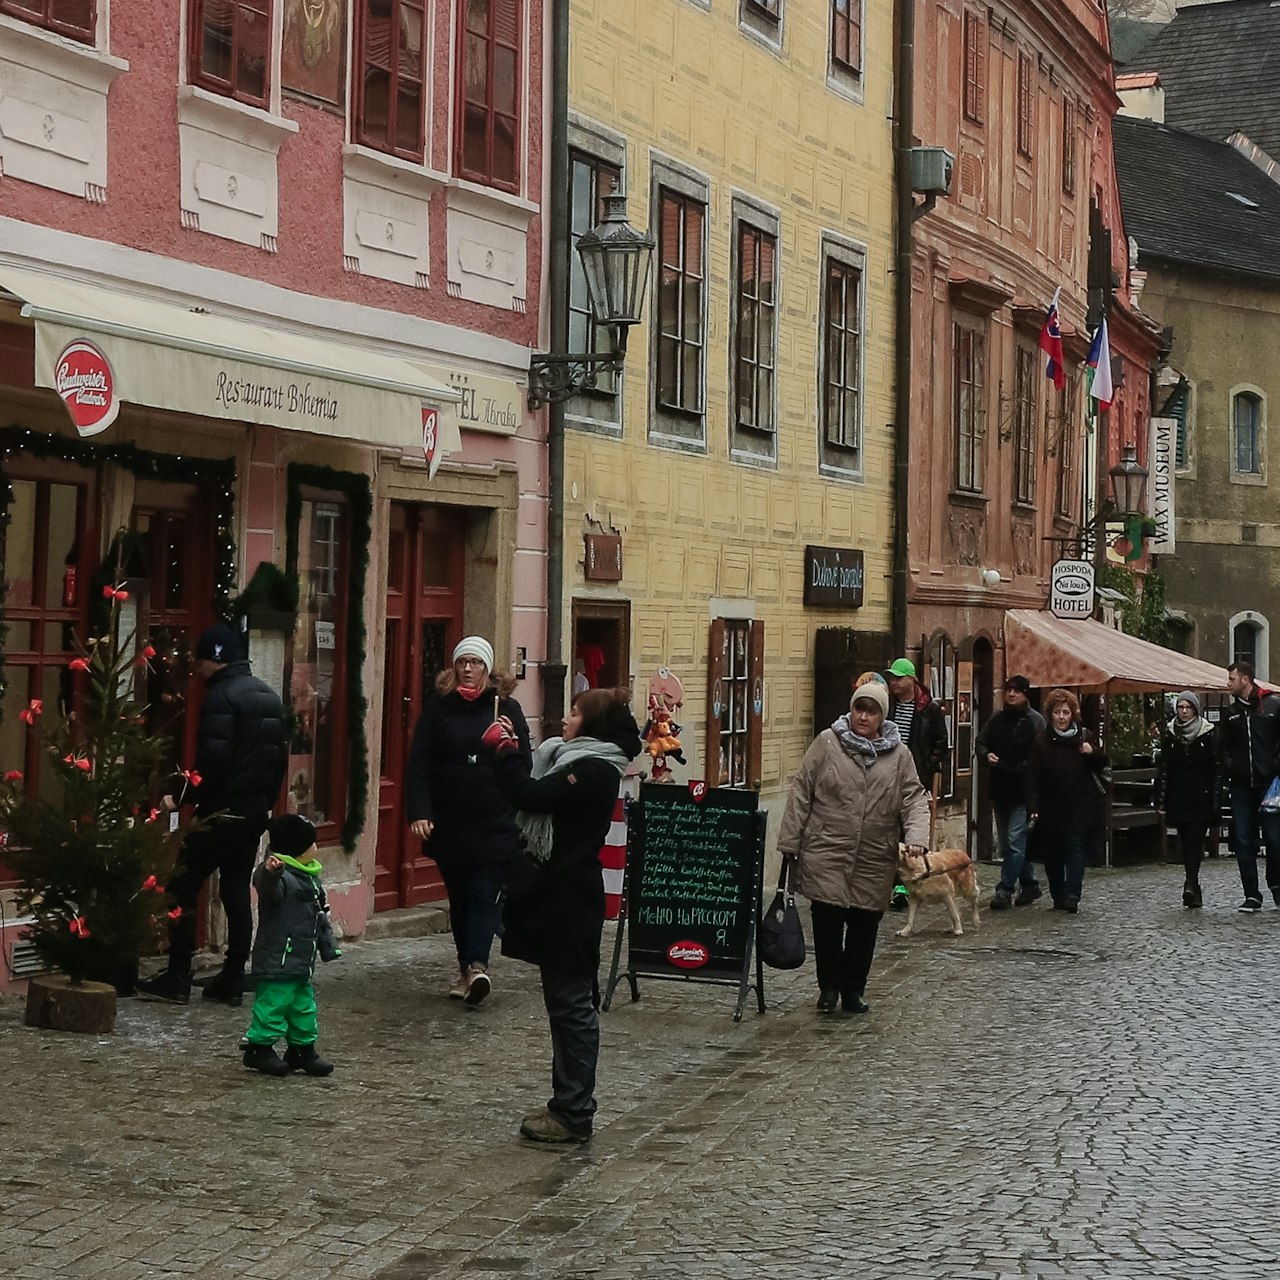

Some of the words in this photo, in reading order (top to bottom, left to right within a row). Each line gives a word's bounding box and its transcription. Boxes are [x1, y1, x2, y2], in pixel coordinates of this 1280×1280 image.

[215, 371, 284, 410] Restaurant
[287, 382, 339, 421] Bohemia
[1155, 426, 1171, 503] MUSEUM
[1154, 508, 1169, 546] WAX
[1054, 564, 1093, 577] HOSPODA
[1053, 597, 1092, 612] HOTEL
